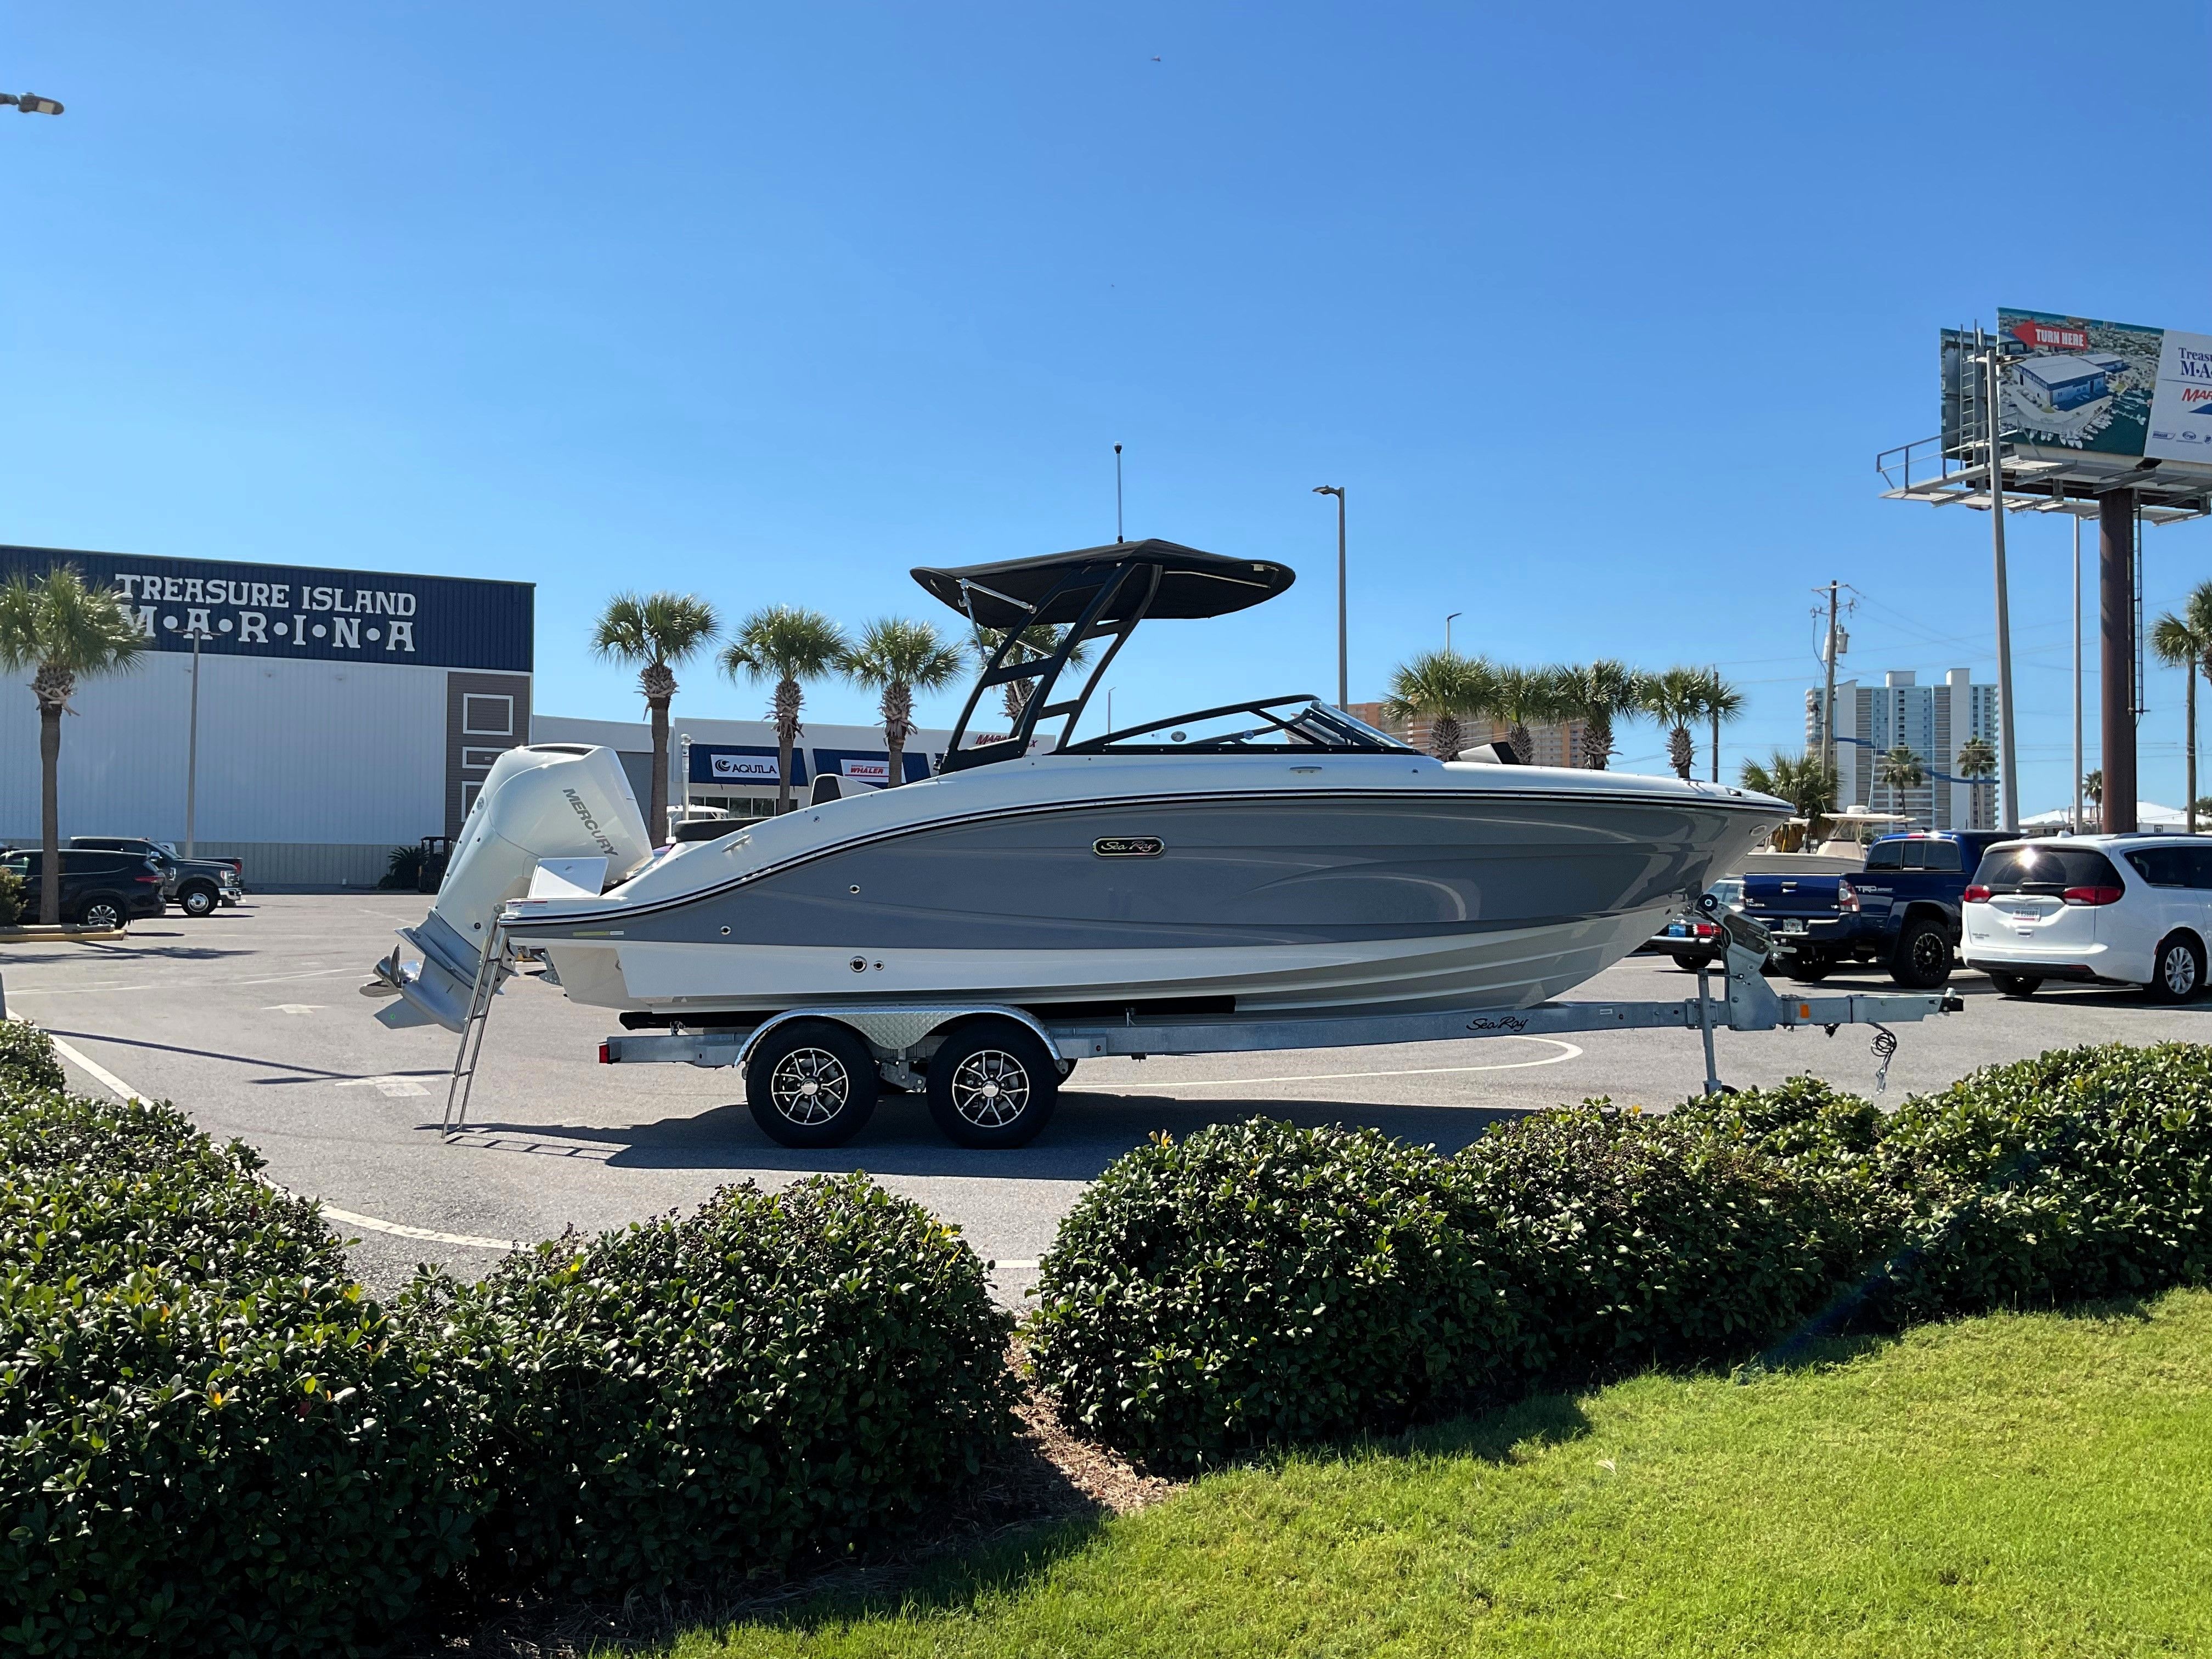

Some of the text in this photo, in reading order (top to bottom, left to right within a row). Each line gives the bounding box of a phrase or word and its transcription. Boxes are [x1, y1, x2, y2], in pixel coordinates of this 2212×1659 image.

[2035, 329, 2084, 346] TURN HERE
[114, 573, 417, 616] TREASURE ISLAND
[732, 764, 777, 774] AQUILA
[562, 788, 619, 856] MERCURY
[1101, 840, 1157, 852] Sea Ray
[1466, 1017, 1529, 1032] Sea Ray
